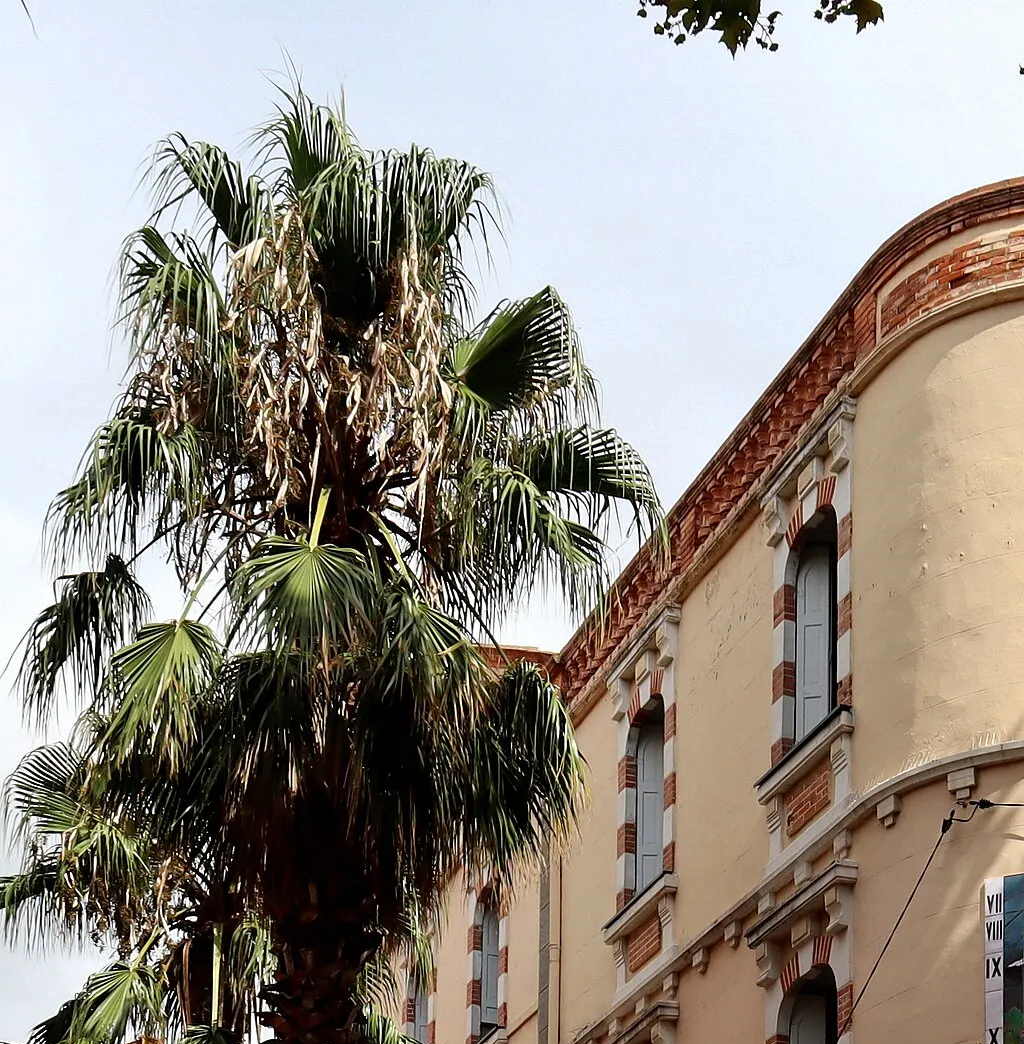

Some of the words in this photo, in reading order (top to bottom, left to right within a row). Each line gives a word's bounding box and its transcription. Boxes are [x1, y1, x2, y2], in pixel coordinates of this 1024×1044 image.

[987, 893, 1002, 914] VII
[986, 920, 1003, 941] VIII
[986, 956, 1002, 979] IX
